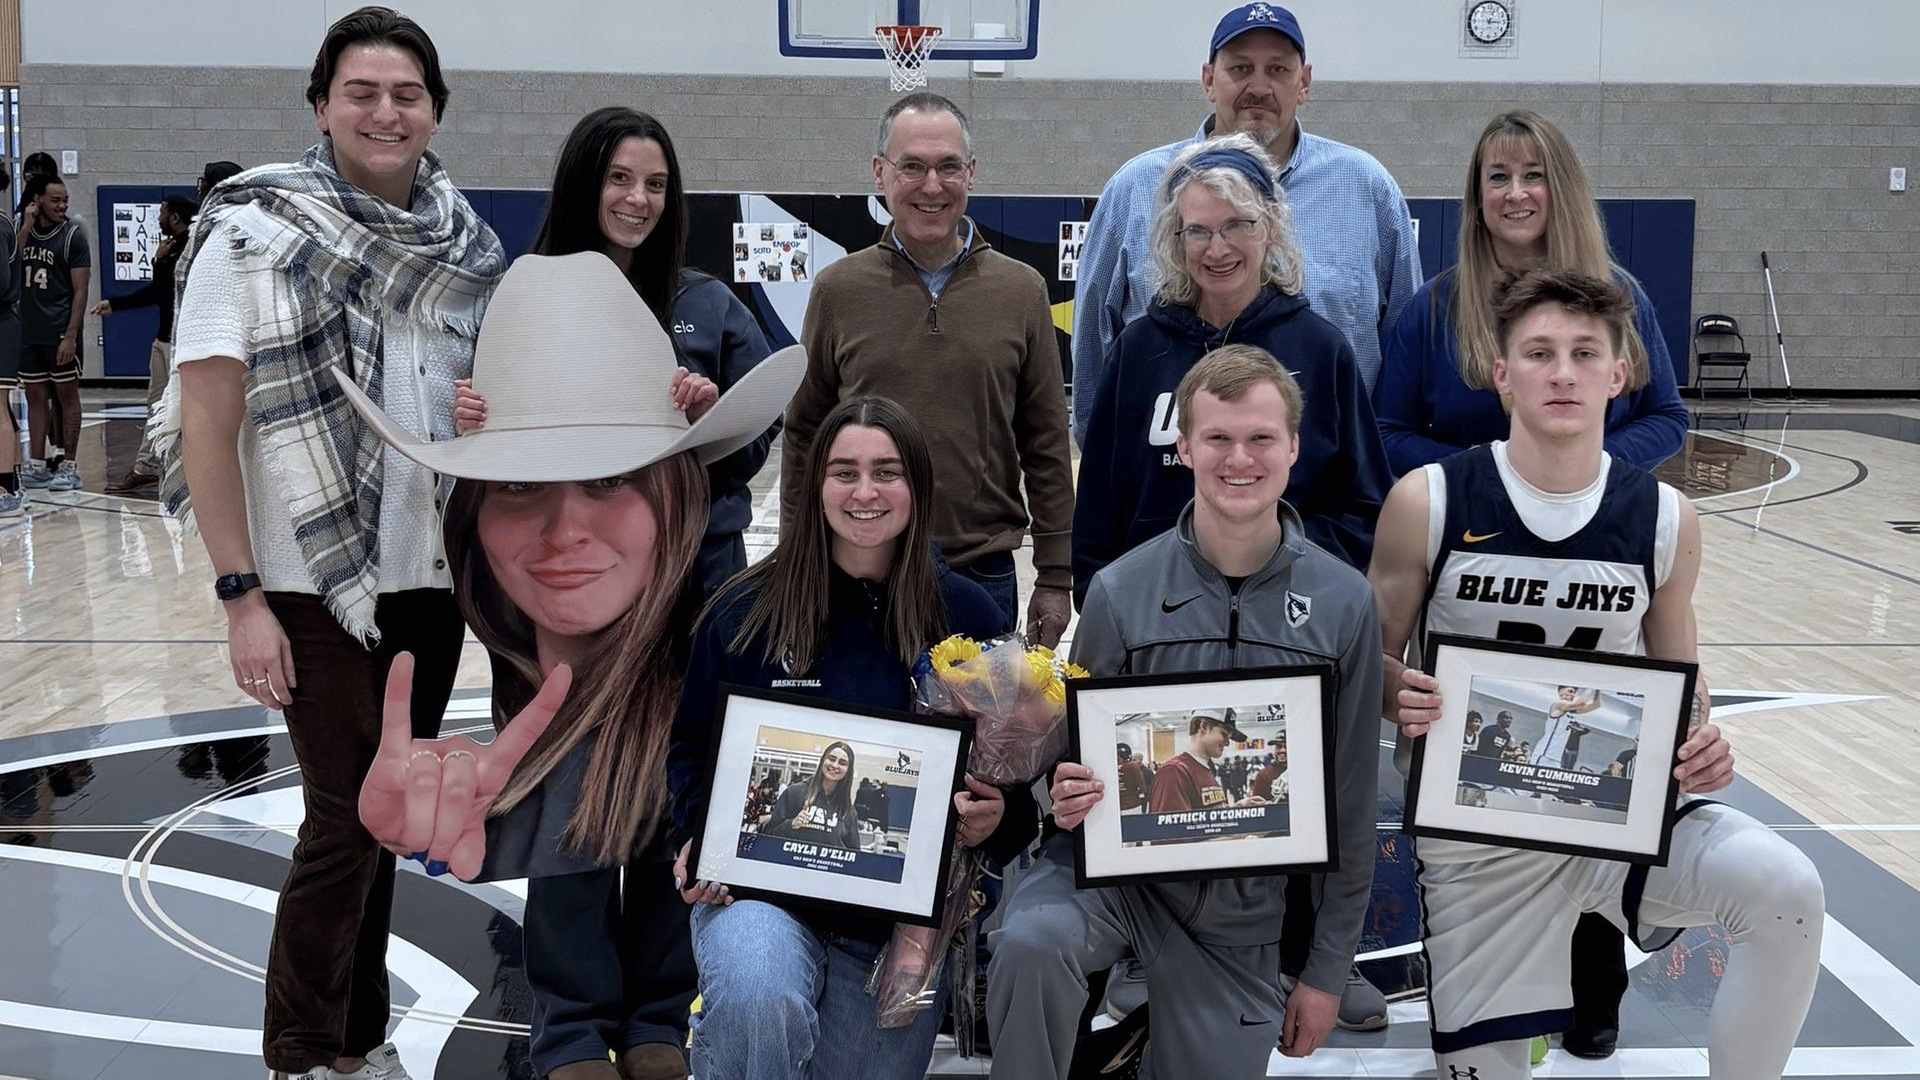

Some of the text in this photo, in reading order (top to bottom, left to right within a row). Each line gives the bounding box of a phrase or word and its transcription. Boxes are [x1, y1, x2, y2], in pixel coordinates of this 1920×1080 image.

[22, 246, 54, 266] ELMS
[25, 265, 48, 289] 14
[1456, 574, 1636, 612] BLUE JAYS
[771, 679, 822, 688] BASKETBALL
[1498, 762, 1536, 777] KEVIN
[1536, 768, 1601, 787] CUMMINGS
[1157, 811, 1208, 826] PATRICK
[1209, 807, 1266, 821] O'CONNOR
[782, 841, 857, 863] CAYLA D'ELIA
